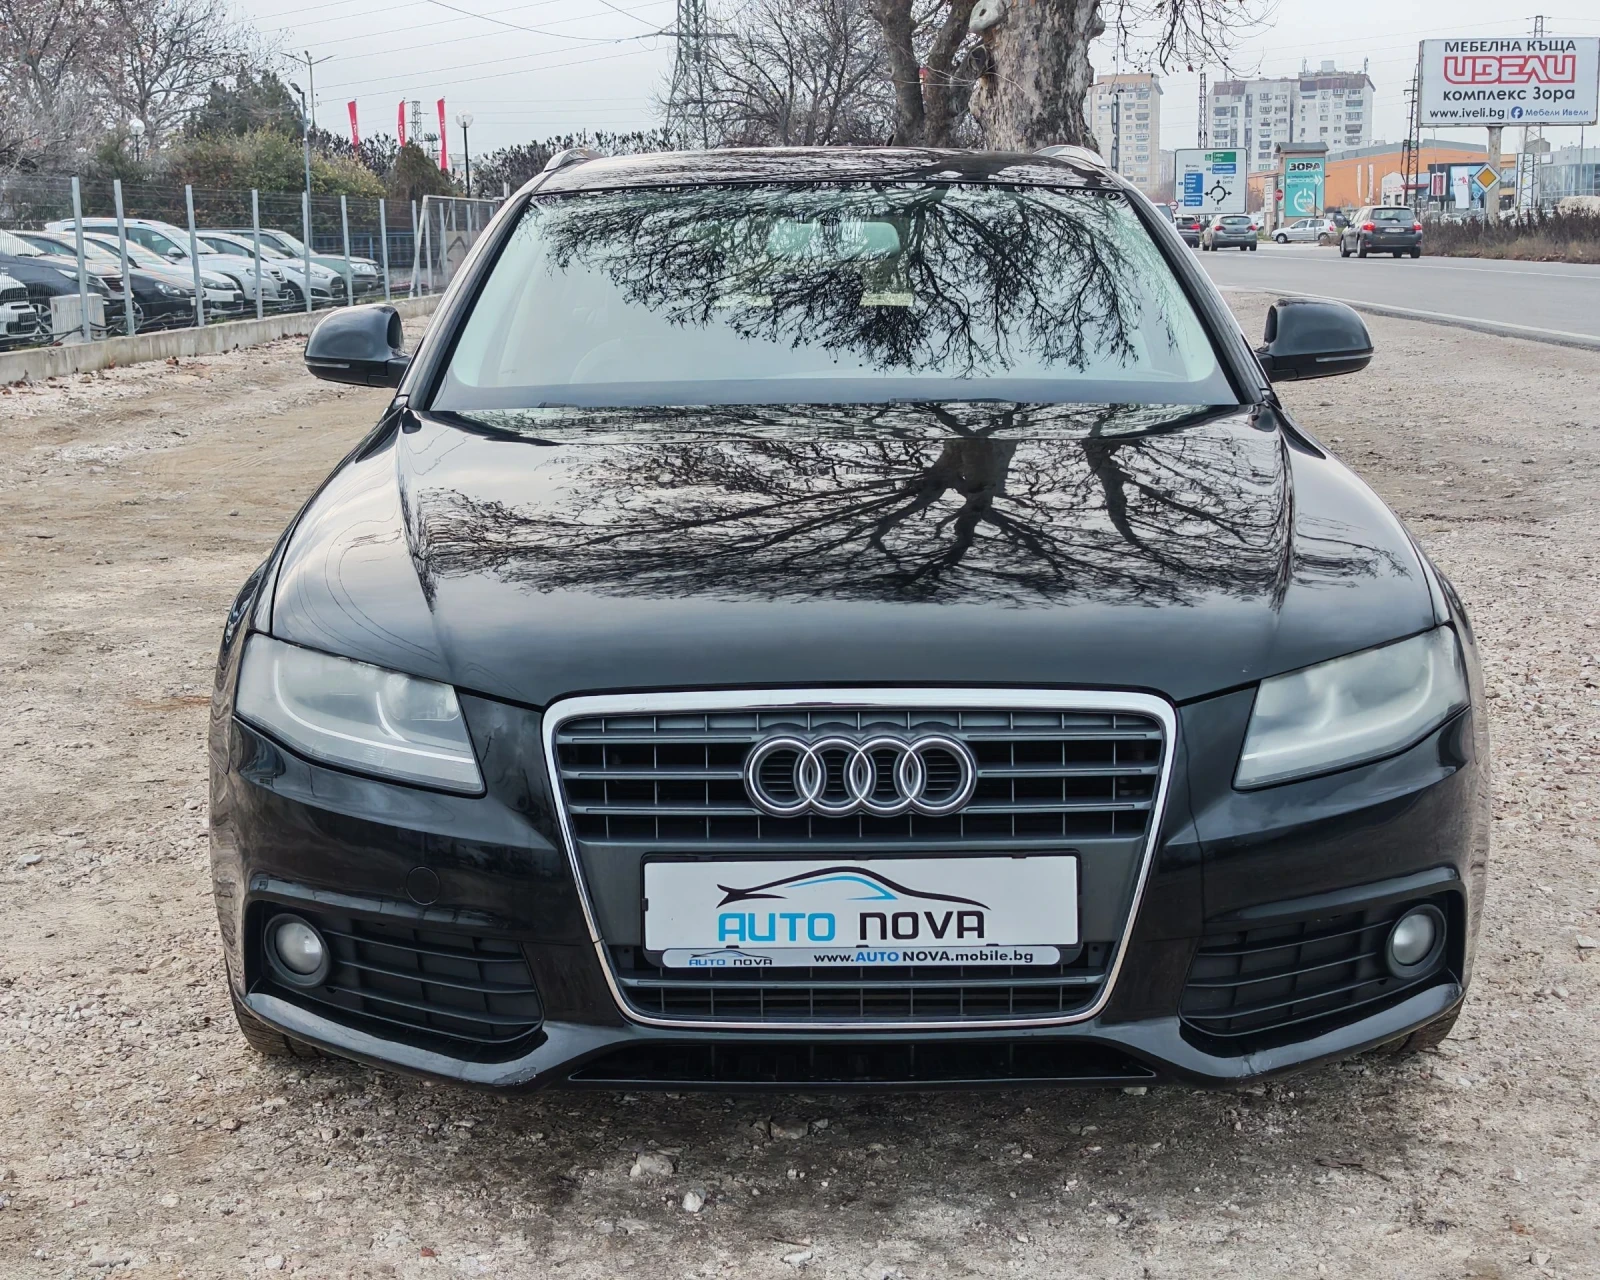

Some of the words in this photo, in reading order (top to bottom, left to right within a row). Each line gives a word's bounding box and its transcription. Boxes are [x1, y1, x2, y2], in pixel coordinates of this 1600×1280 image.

[1444, 40, 1522, 53] МЕБЕЛНА
[1526, 39, 1577, 54] КЪЩА
[1443, 54, 1577, 85] ИВЕЛИ
[1443, 88, 1527, 102] комплекс
[1532, 86, 1575, 103] Зора
[1429, 107, 1505, 120] www.iveli.bg
[1525, 108, 1560, 117] Мебели
[1562, 108, 1589, 116] Ивели
[1289, 161, 1322, 172] ЗОРА
[717, 912, 836, 942] AUTO
[858, 909, 986, 940] NOVA
[688, 958, 726, 966] AUTO
[733, 958, 773, 966] NOVA
